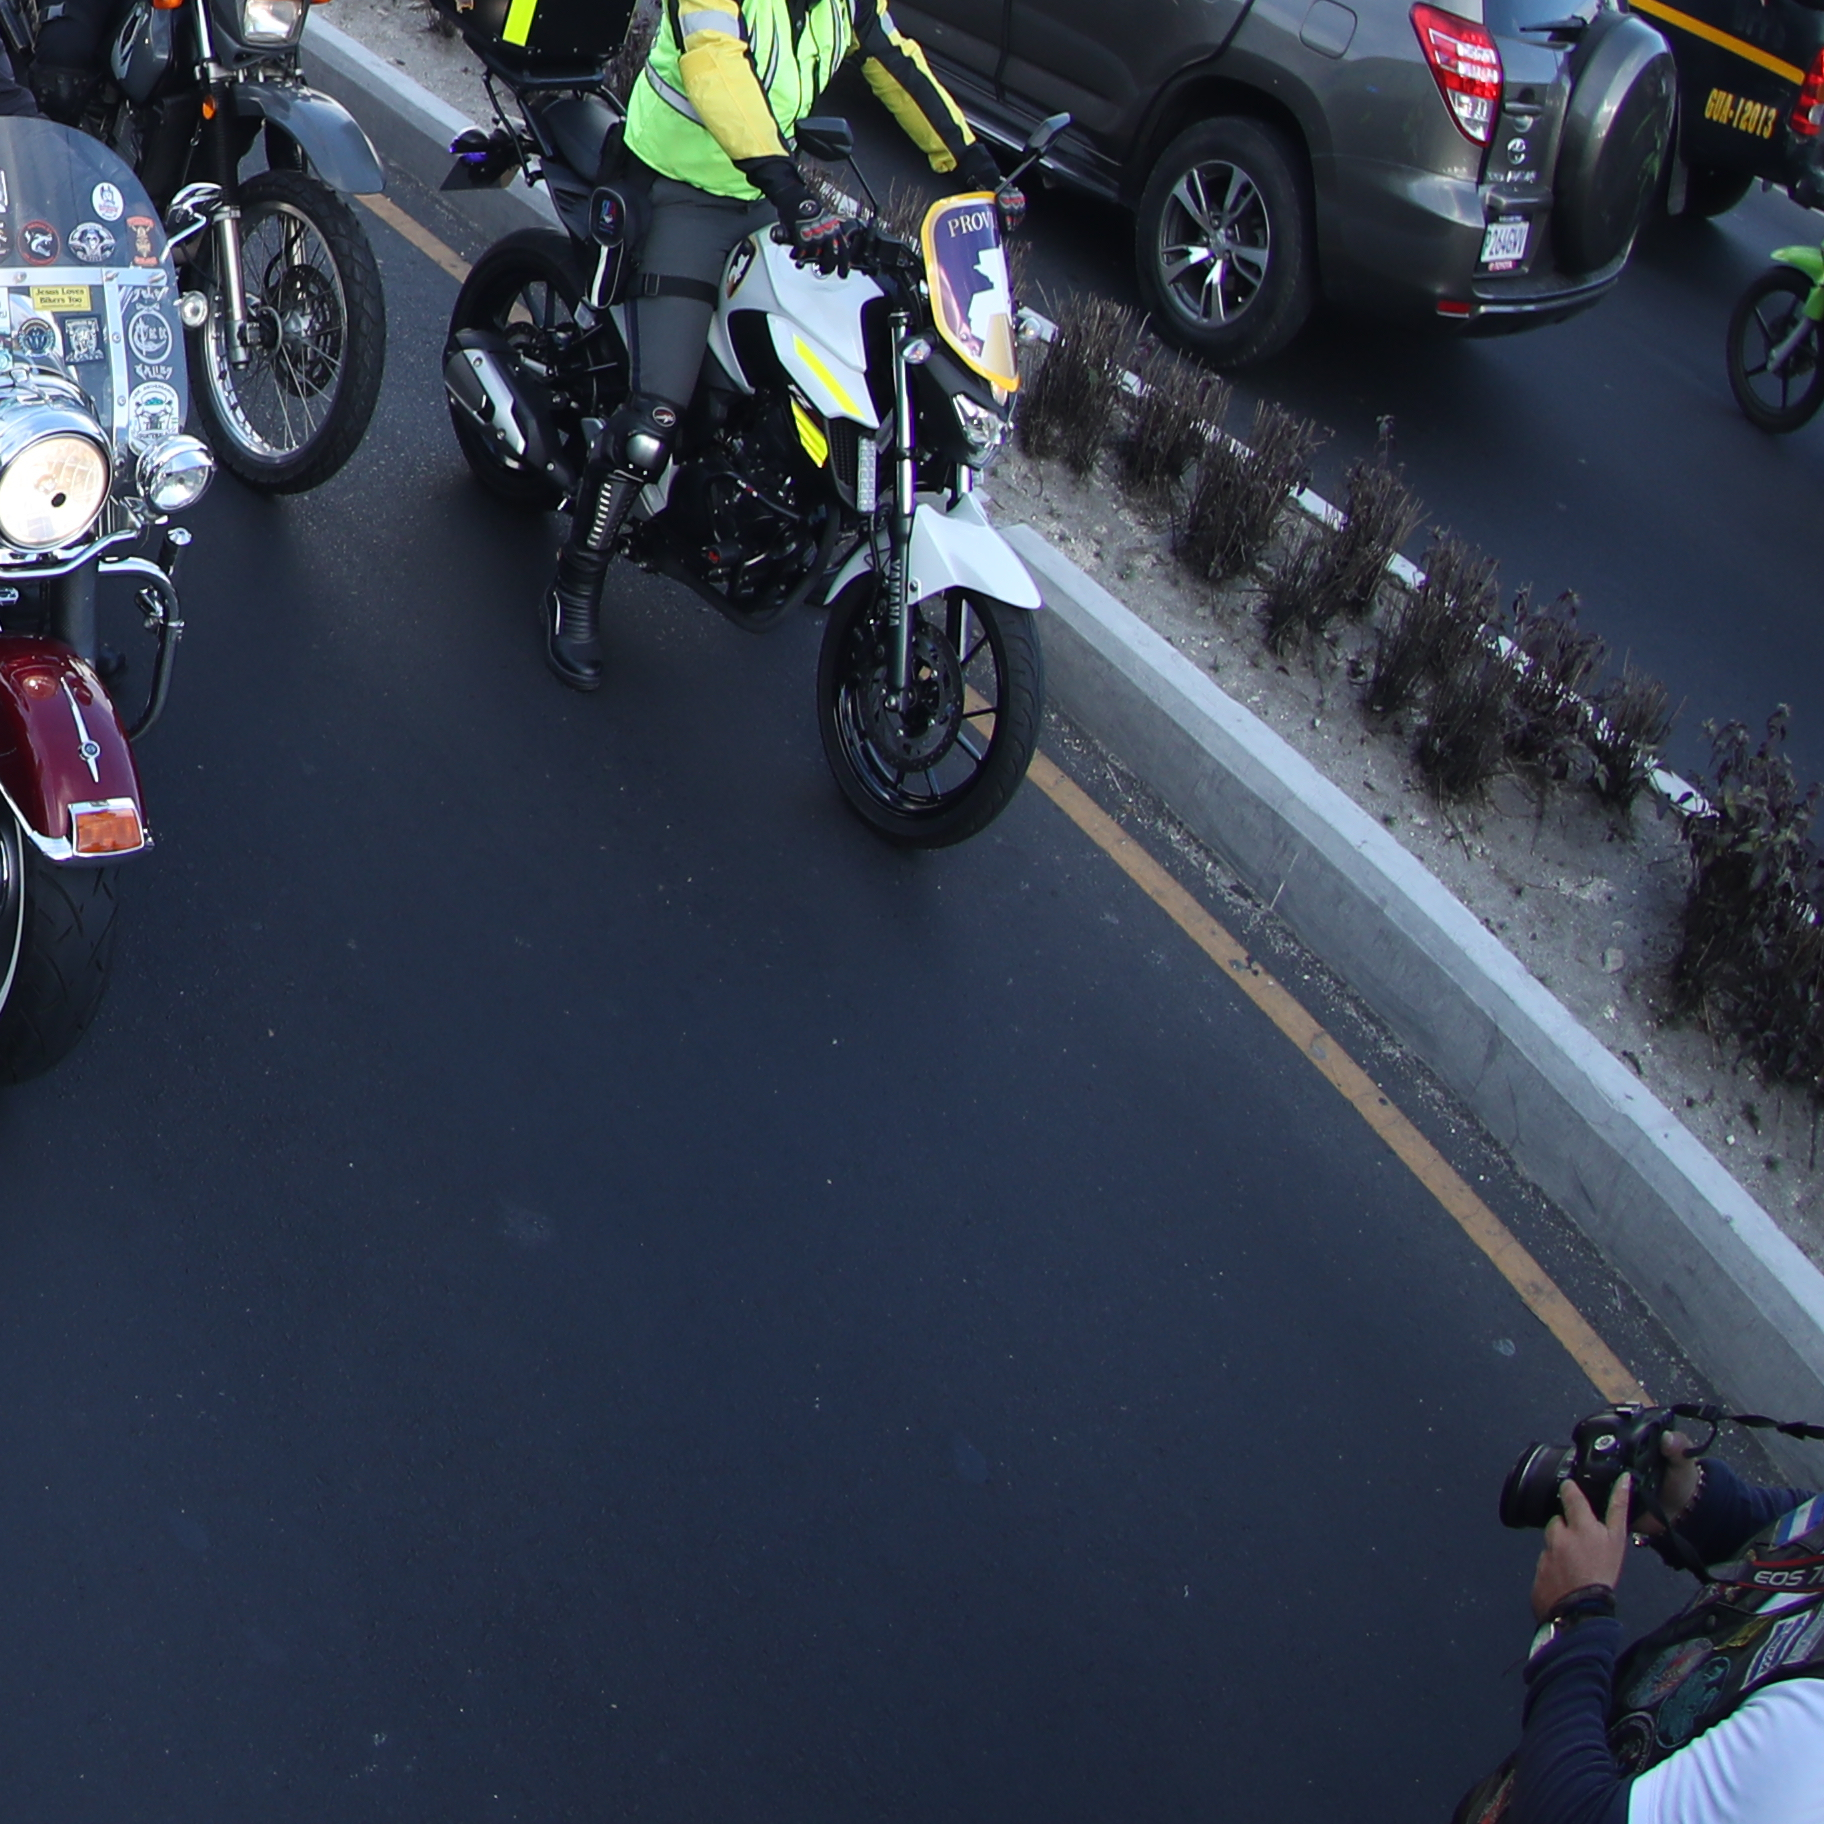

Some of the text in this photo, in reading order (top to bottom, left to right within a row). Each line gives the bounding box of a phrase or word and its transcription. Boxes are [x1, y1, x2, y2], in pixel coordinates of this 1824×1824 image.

[35, 287, 85, 297] Jesus Loves
[39, 296, 83, 304] Bikers Too
[888, 558, 902, 627] YAMAHA
[1753, 1569, 1807, 1587] EOS
